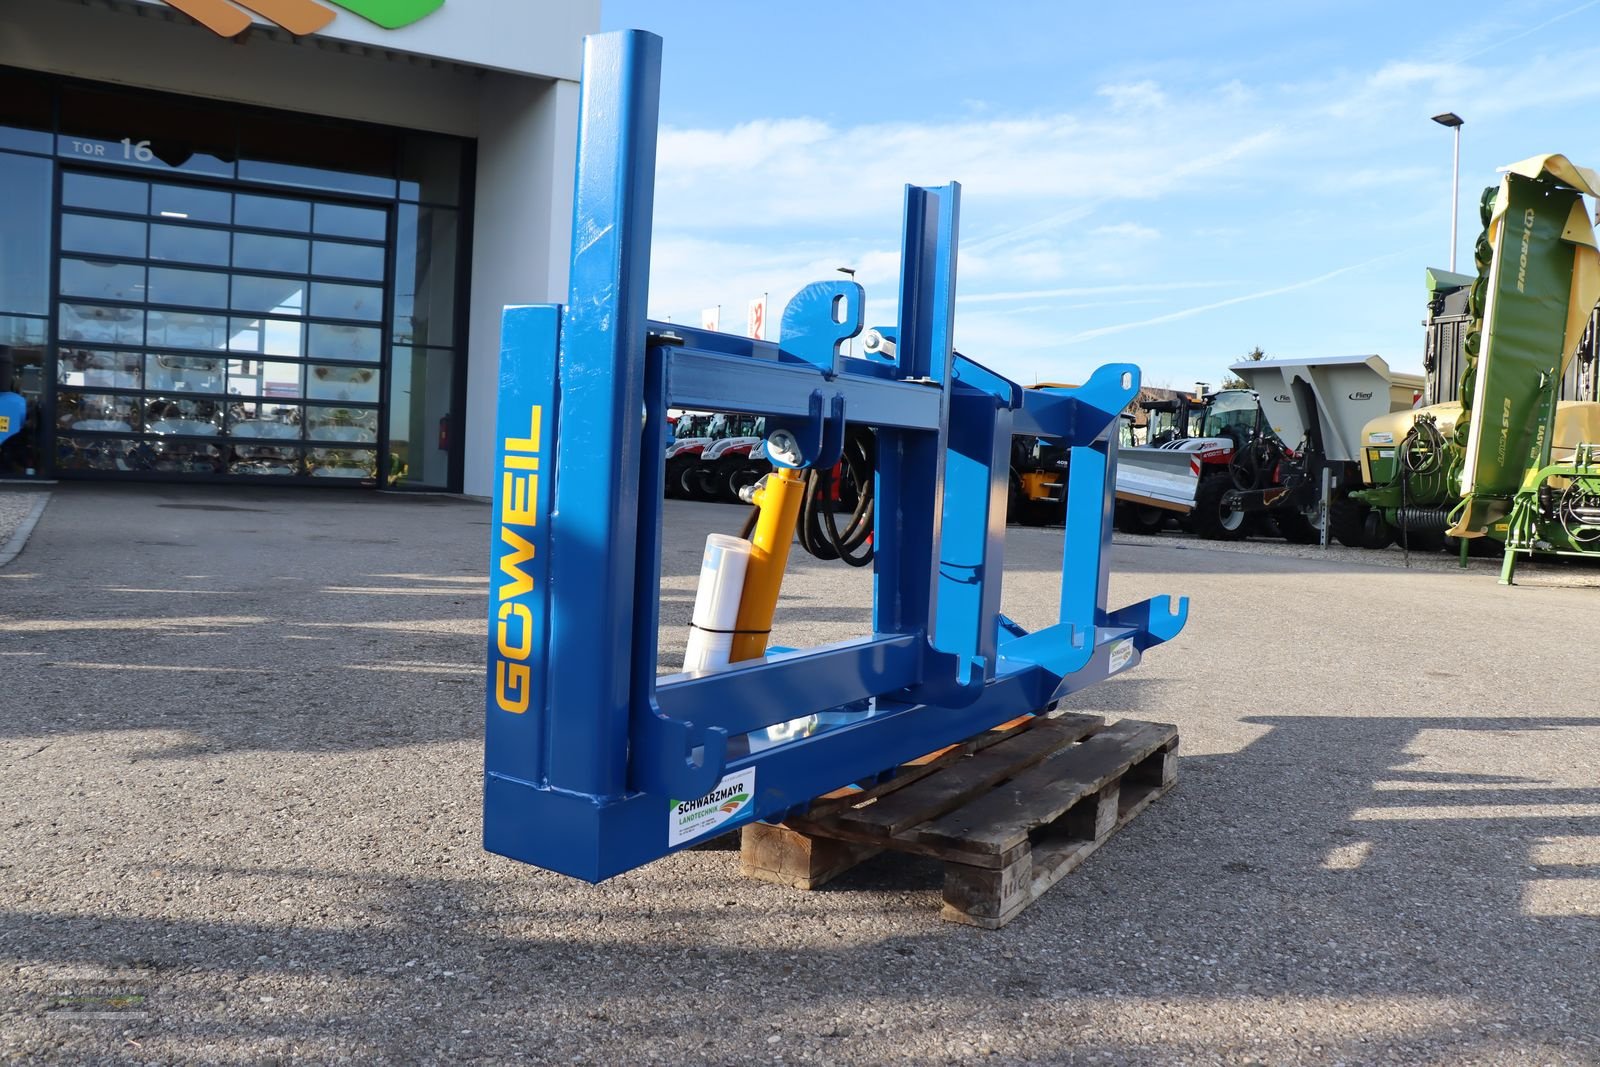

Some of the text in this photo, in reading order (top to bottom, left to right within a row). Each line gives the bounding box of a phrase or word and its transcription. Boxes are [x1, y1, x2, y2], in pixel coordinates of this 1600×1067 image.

[72, 138, 153, 162] TOR 16
[1517, 228, 1530, 294] KRONE
[678, 783, 744, 815] SCHWARZMAYR
[679, 805, 718, 825] LANDTECHNIK
